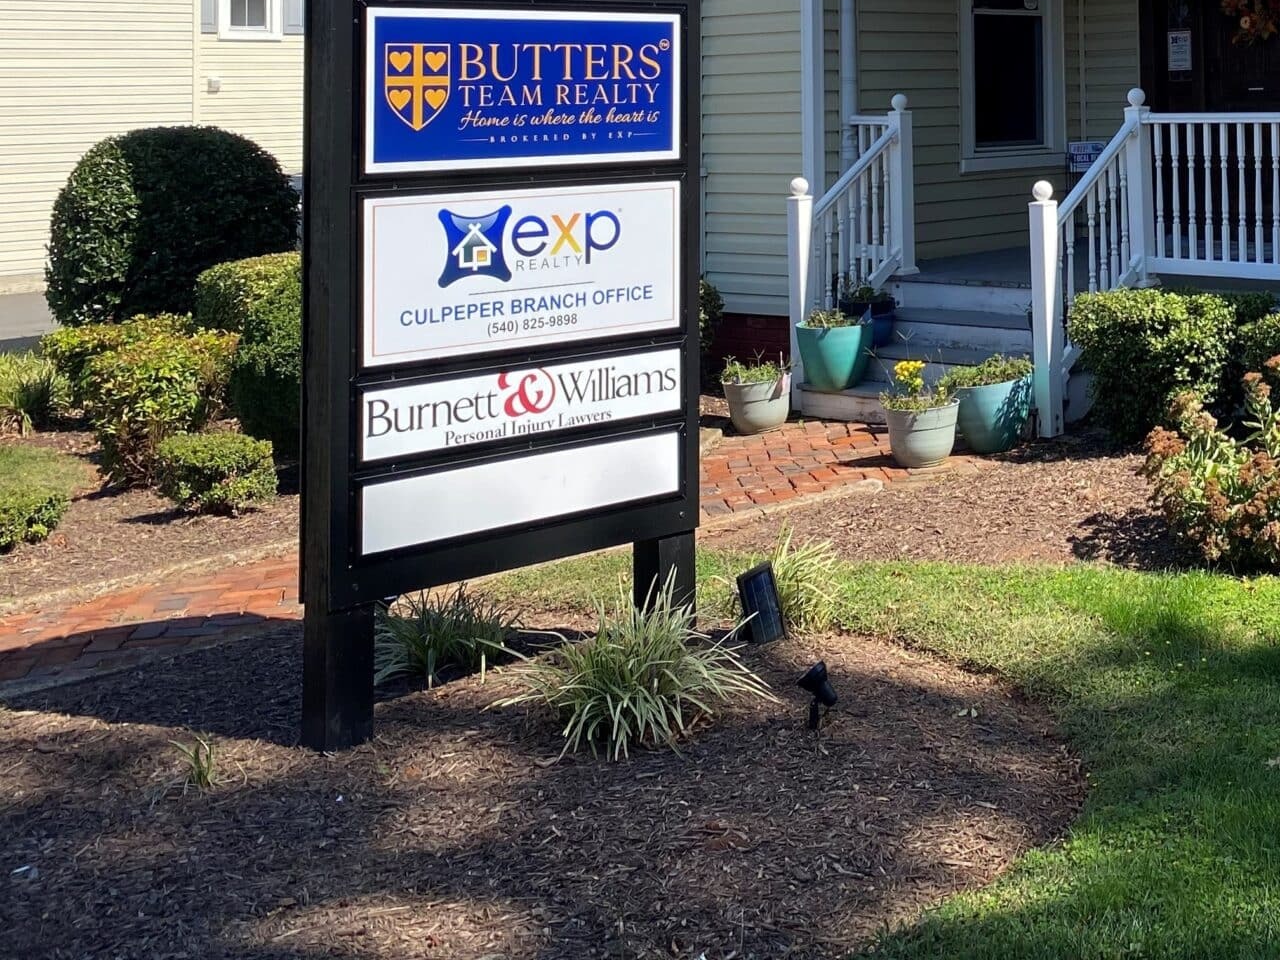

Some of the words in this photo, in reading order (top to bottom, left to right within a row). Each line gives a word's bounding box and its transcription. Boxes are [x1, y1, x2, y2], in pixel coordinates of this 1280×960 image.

[458, 43, 662, 82] BUTTERS
[458, 84, 543, 107] TEAM
[556, 83, 660, 105] REALTY
[457, 110, 510, 130] Home
[513, 112, 529, 126] is
[530, 108, 576, 125] where
[578, 107, 602, 124] the
[605, 107, 645, 124] heart
[647, 110, 660, 123] is
[490, 134, 570, 144] BROKERED
[582, 132, 597, 141] BY
[511, 210, 621, 265] exp
[515, 254, 583, 272] REALTY
[400, 300, 504, 327] CULPEPER
[511, 292, 587, 315] BRANCH
[592, 285, 654, 306] OFFICE
[487, 319, 519, 338] (540)
[522, 313, 578, 331] 825-9898
[366, 389, 500, 438] Burnett
[498, 367, 556, 418] &
[557, 365, 677, 405] Williams
[445, 425, 508, 446] Personal
[511, 417, 553, 436] Injury
[558, 409, 612, 429] Lawyers
